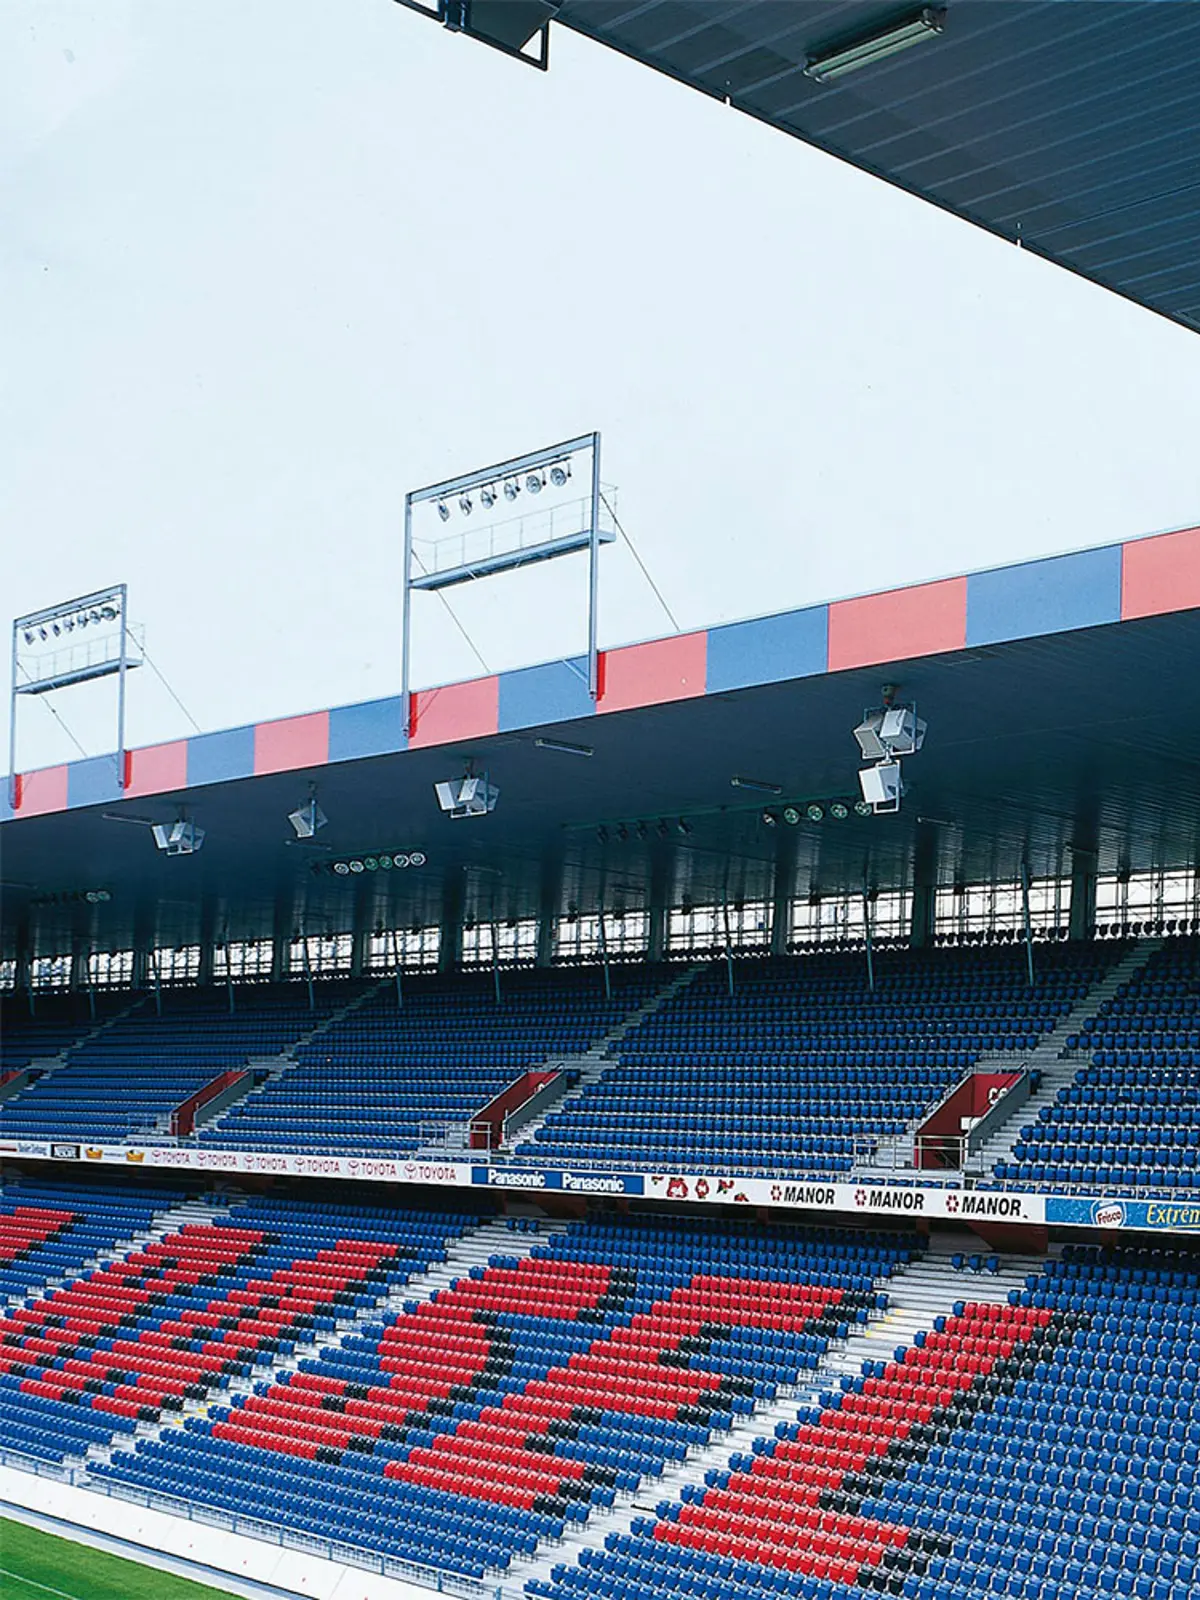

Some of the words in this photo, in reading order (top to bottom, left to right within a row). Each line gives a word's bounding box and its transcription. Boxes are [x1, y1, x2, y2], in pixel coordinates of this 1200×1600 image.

[162, 1151, 191, 1165] TOYOTA
[207, 1154, 238, 1168] TOYOTA
[256, 1158, 287, 1171] TOYOTA
[307, 1162, 340, 1173] TOYOTA
[361, 1163, 397, 1176] TOYOTA
[418, 1167, 456, 1180] TOYOTA
[487, 1169, 546, 1188] Panasonic
[562, 1173, 625, 1193] Panasonic
[783, 1186, 835, 1205] MANOR
[869, 1191, 924, 1211] MANOR
[961, 1197, 1022, 1217] MANOR
[1097, 1206, 1122, 1225] Frisco
